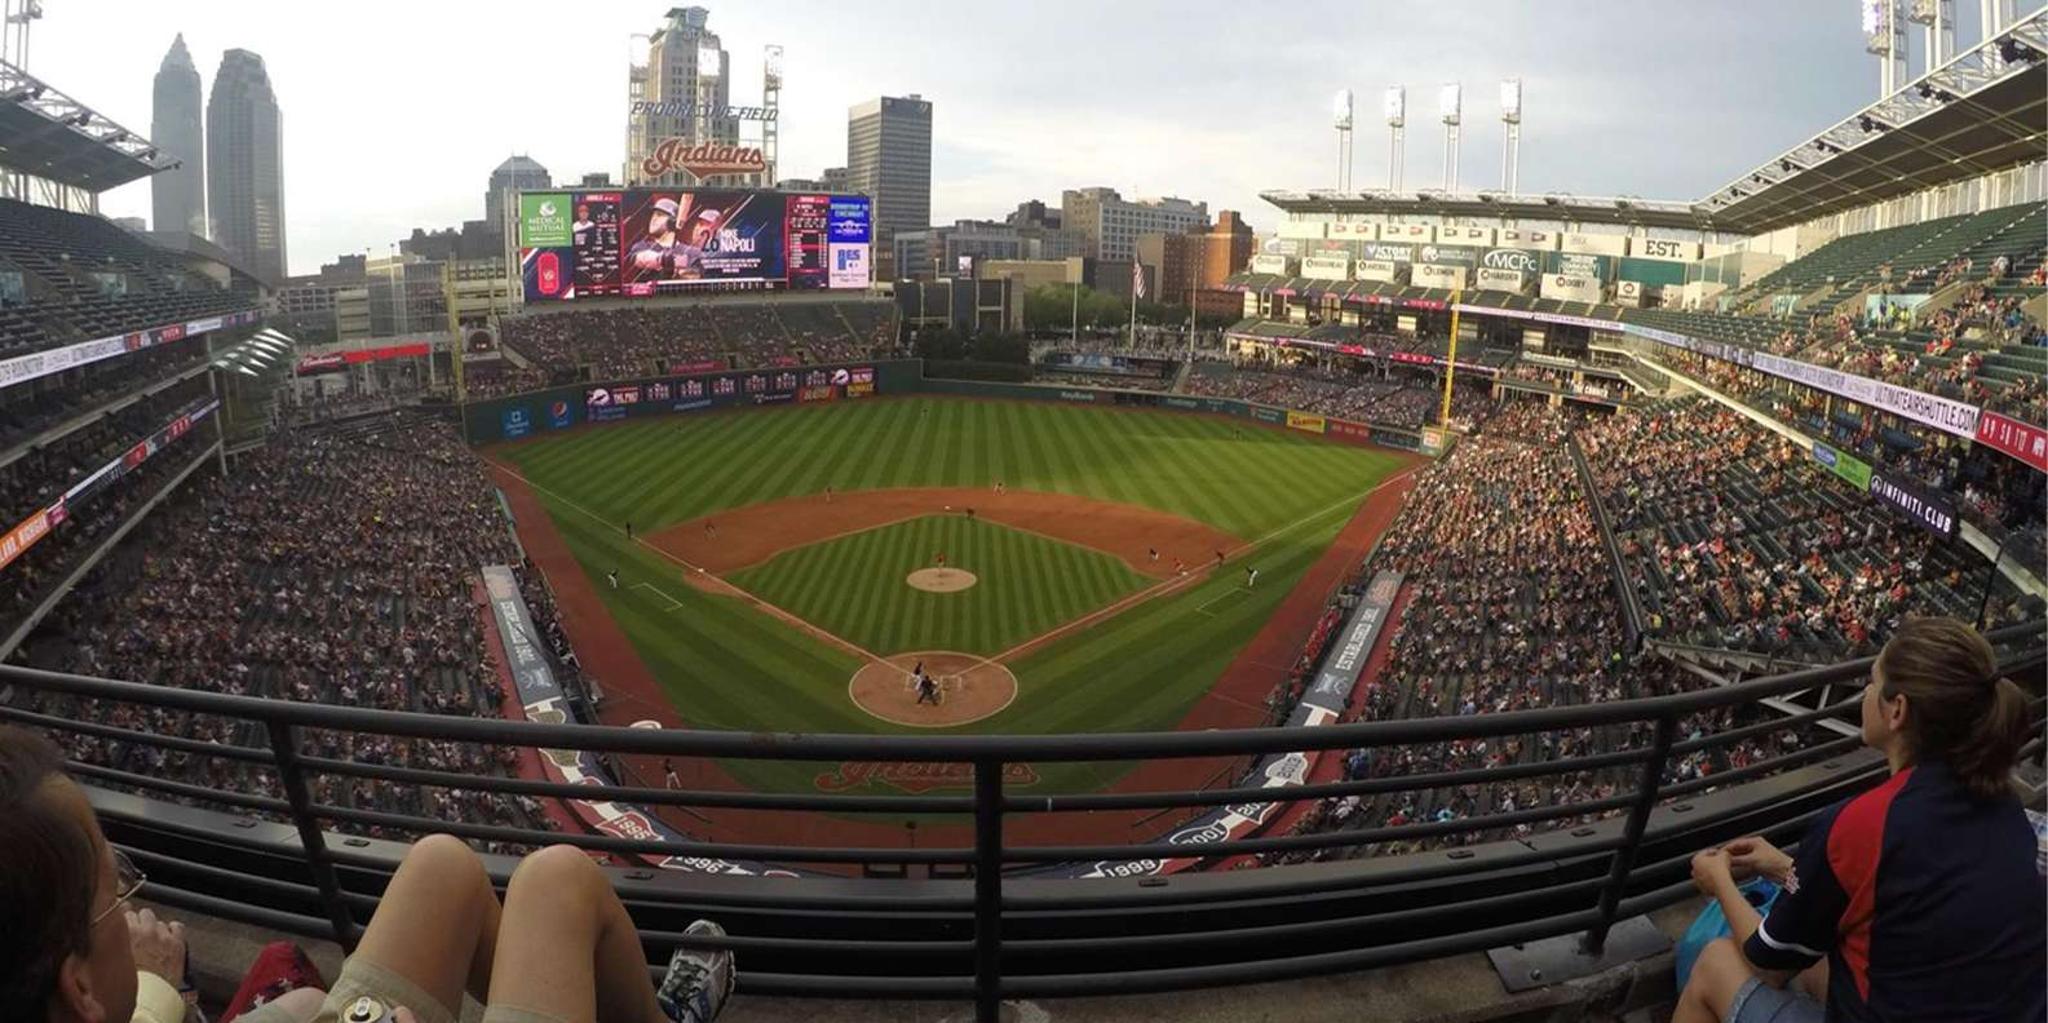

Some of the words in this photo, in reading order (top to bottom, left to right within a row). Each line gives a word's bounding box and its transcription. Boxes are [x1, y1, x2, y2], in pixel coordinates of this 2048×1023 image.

[739, 106, 779, 121] FIELD
[643, 138, 766, 179] Indians
[701, 230, 719, 253] 26
[720, 239, 755, 252] NAPOLI
[1645, 241, 1683, 258] EST.
[1882, 481, 1922, 516] INFINITI
[1924, 506, 1952, 533] CLUB
[1335, 623, 1372, 671] ESTABLISHED
[613, 816, 651, 840] 1995
[1105, 858, 1156, 878] 1999
